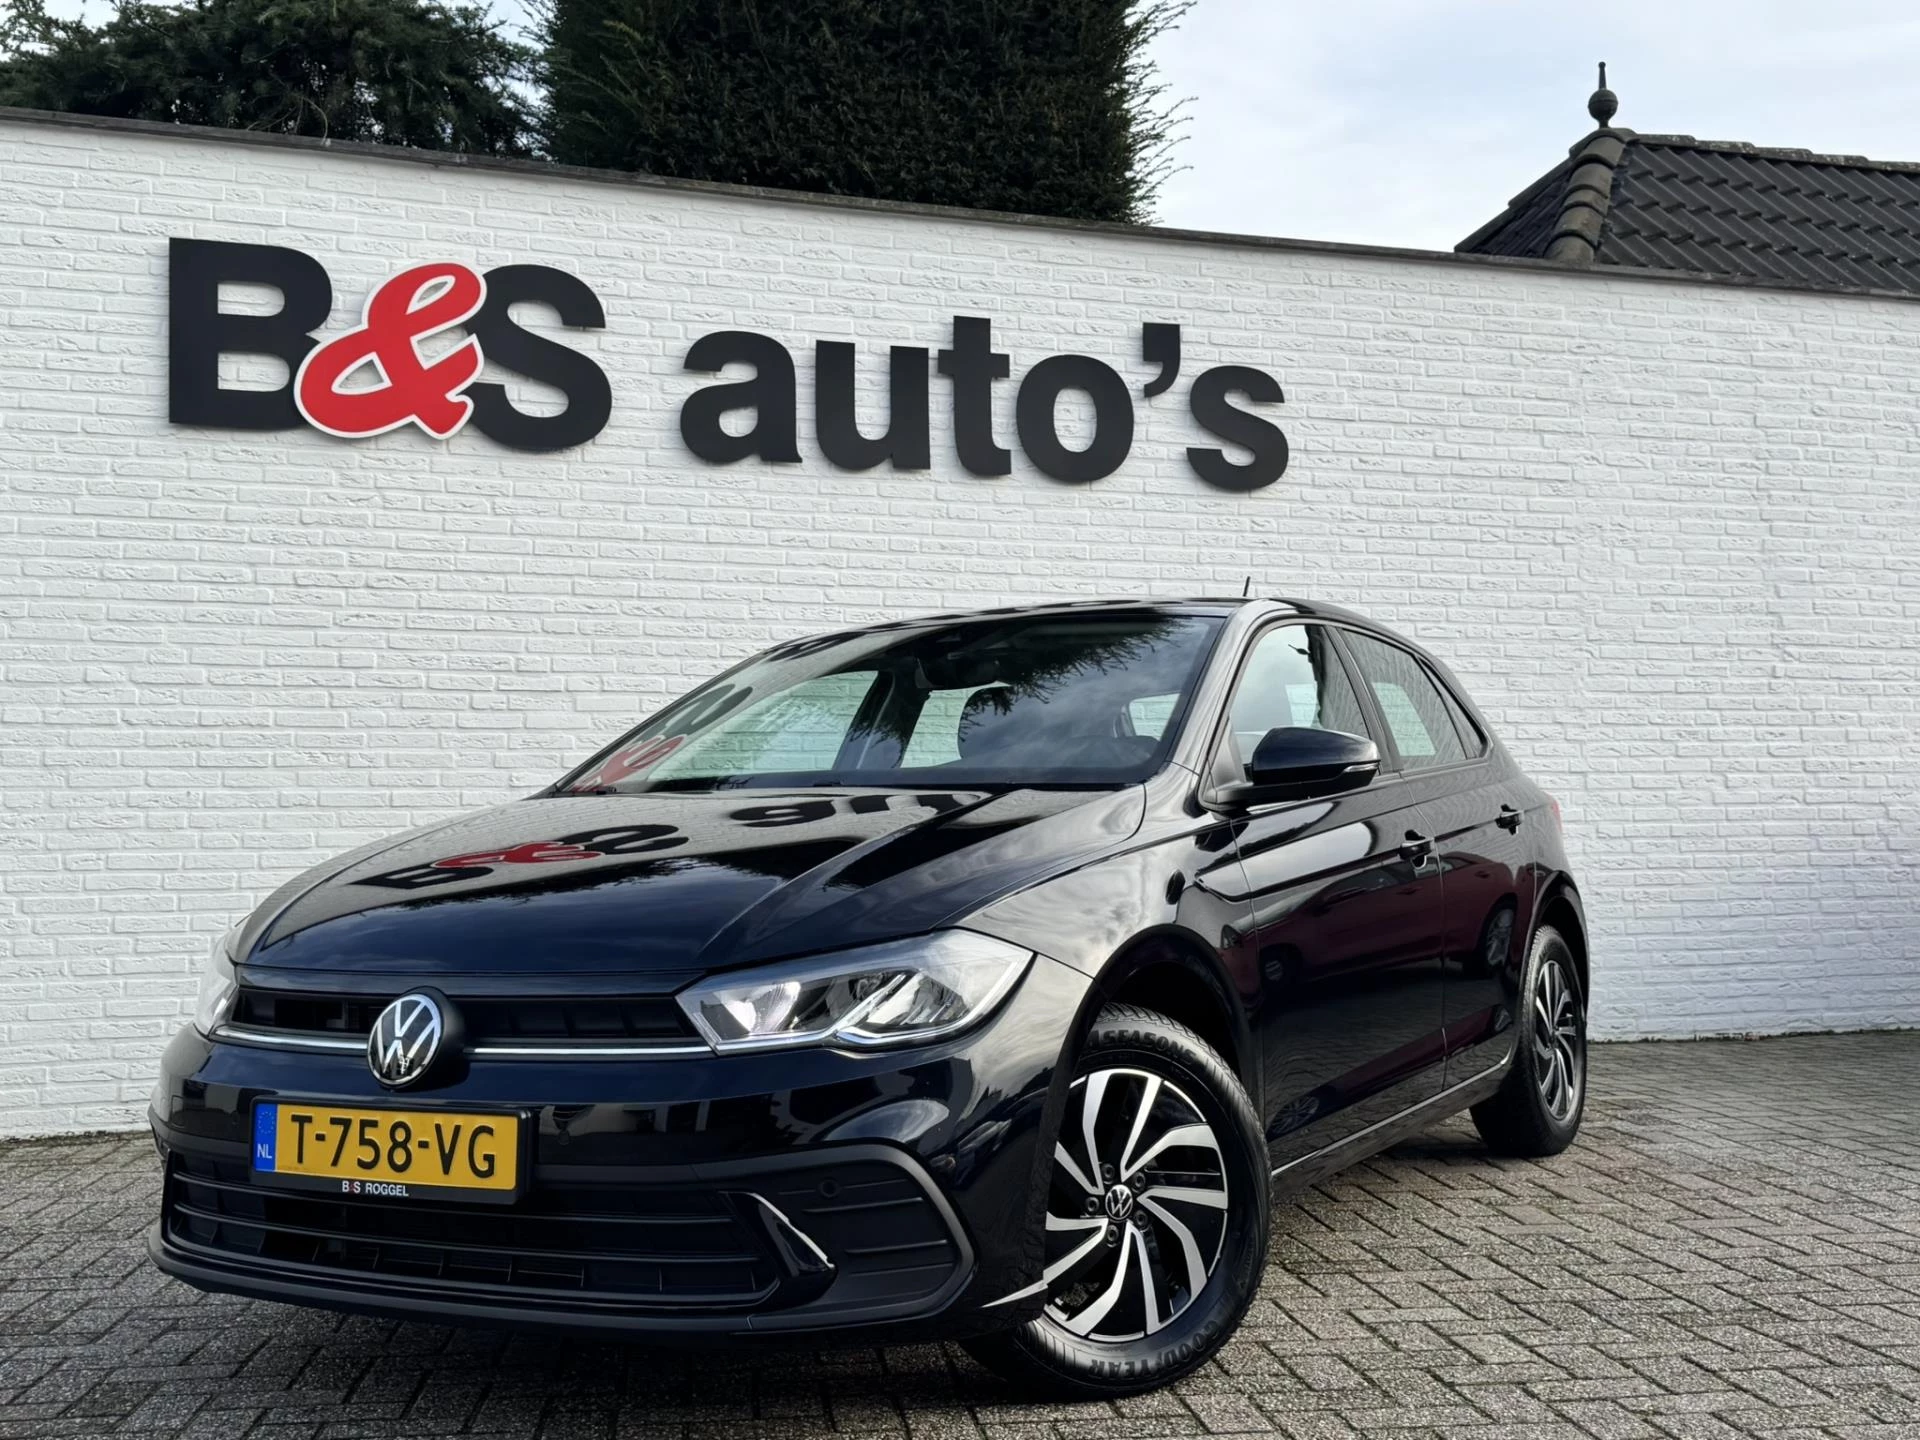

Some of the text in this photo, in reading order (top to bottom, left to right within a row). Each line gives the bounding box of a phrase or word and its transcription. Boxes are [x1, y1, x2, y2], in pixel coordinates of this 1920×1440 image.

[169, 237, 1290, 493] B&S auto's
[257, 1143, 273, 1159] NL
[291, 1113, 496, 1179] T-758-VG
[365, 1182, 409, 1197] ROGGEL
